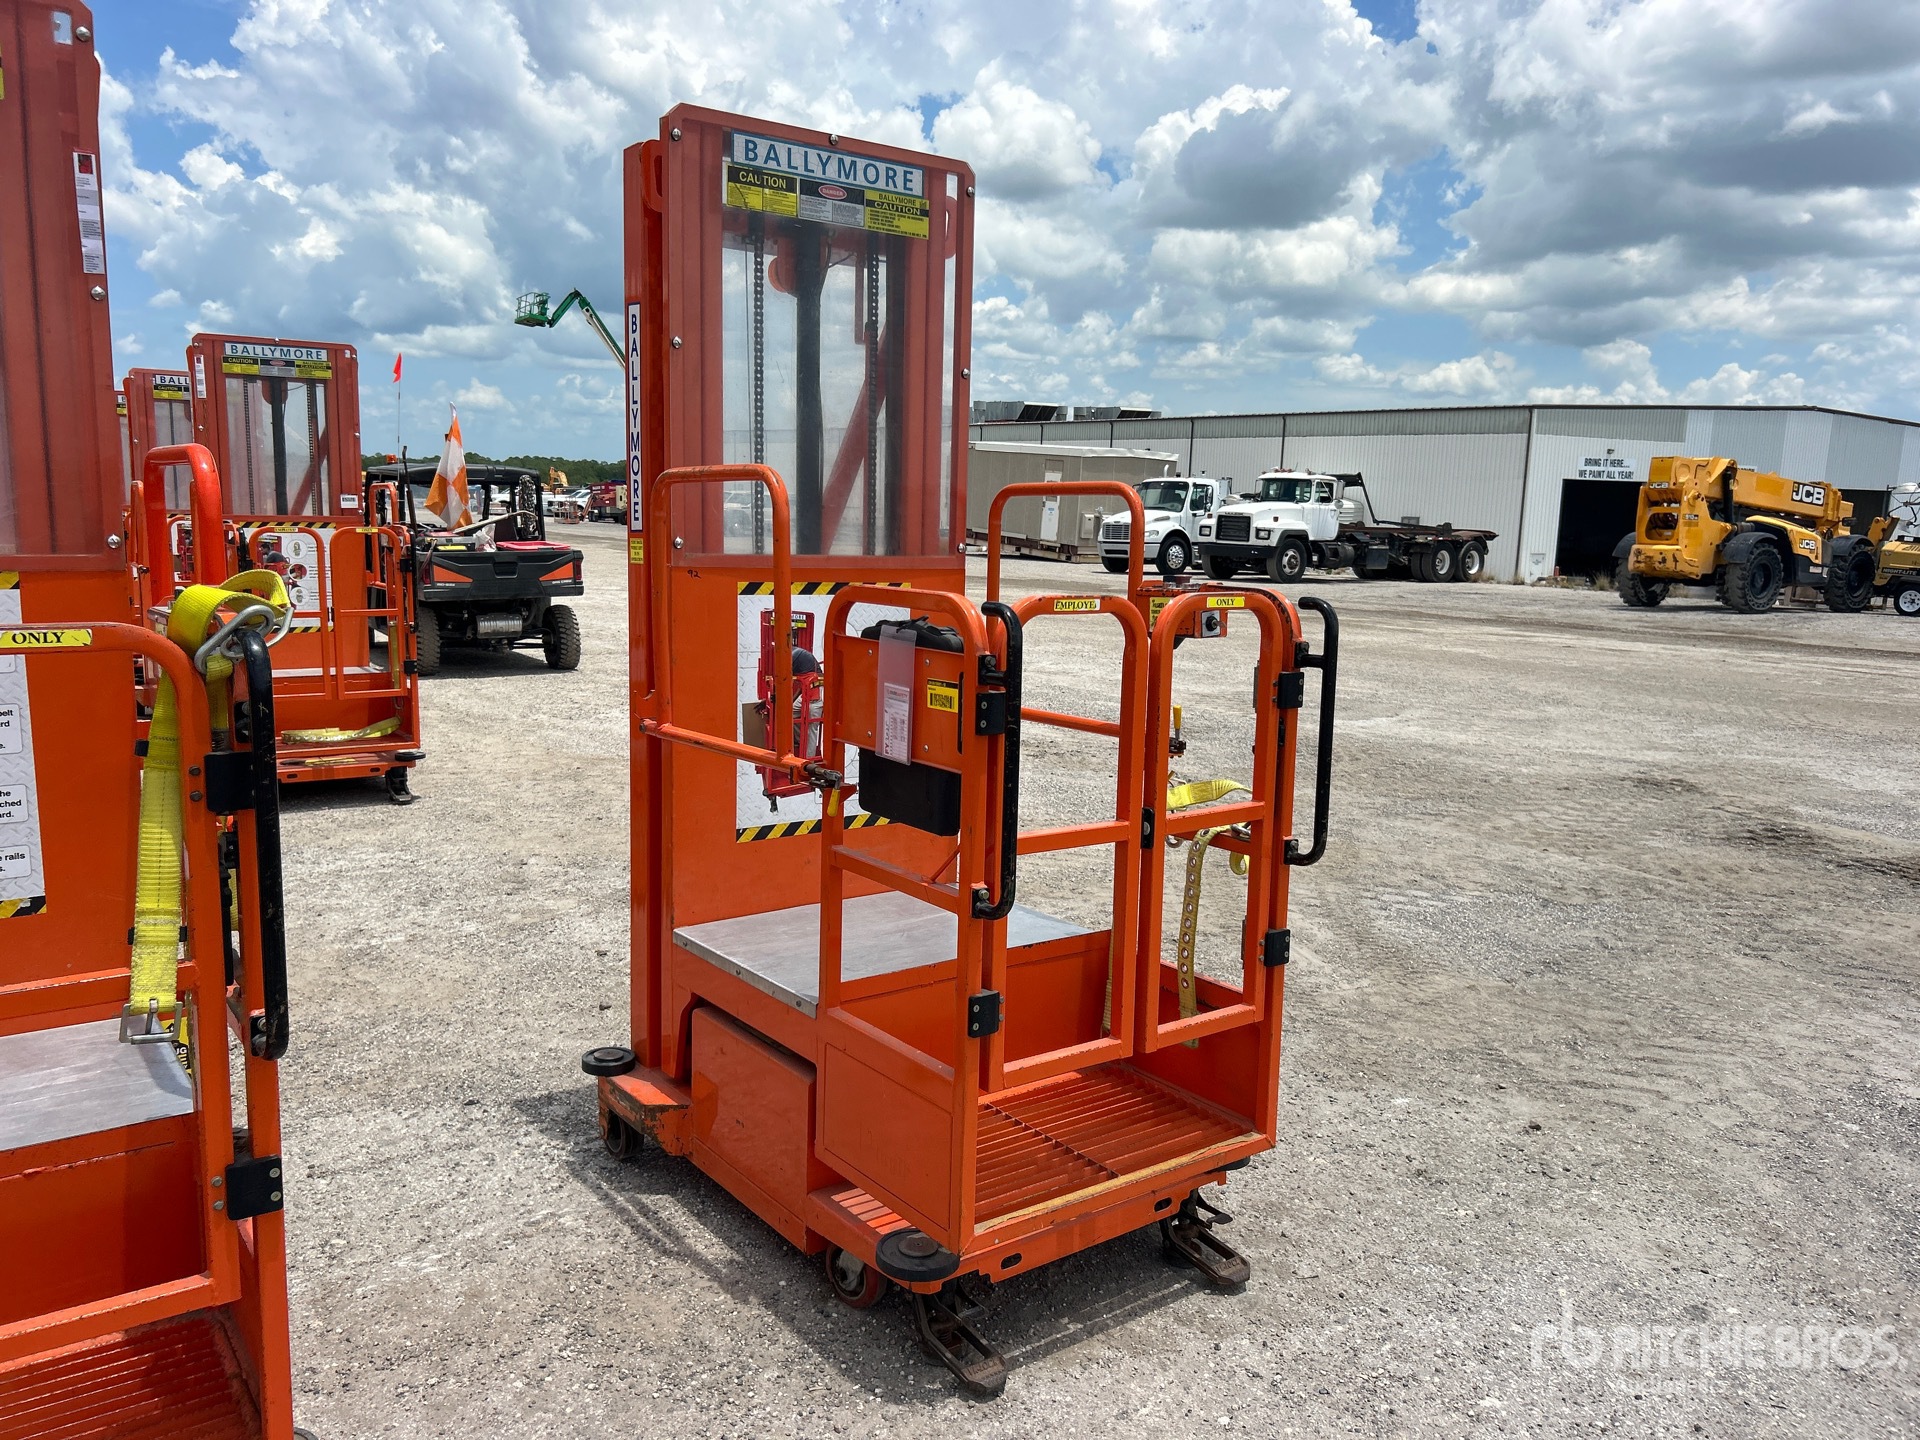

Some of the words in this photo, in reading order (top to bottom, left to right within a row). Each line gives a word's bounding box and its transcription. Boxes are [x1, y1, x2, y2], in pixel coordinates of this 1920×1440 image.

[745, 138, 913, 191] BALLYMORE
[739, 171, 787, 189] CAUTION
[822, 188, 843, 197] DANGER
[878, 194, 916, 206] BALLYMORE
[874, 202, 920, 215] CAUTION
[231, 344, 322, 360] BALLYMORE
[631, 314, 640, 521] BALLYMORE
[1584, 458, 1602, 467] BRING
[1602, 458, 1608, 467] IT
[1610, 458, 1630, 468] HERE...
[1578, 470, 1587, 478] WE
[1588, 470, 1605, 478] PAINT
[1606, 470, 1616, 479] ALL
[1618, 471, 1634, 480] YEAR!
[1792, 484, 1825, 505] JCB
[1800, 540, 1816, 550] JCB
[1883, 568, 1918, 576] NIGHT-LITE
[1216, 598, 1236, 606] ONLY
[11, 632, 65, 644] ONLY
[5, 852, 26, 861] rails
